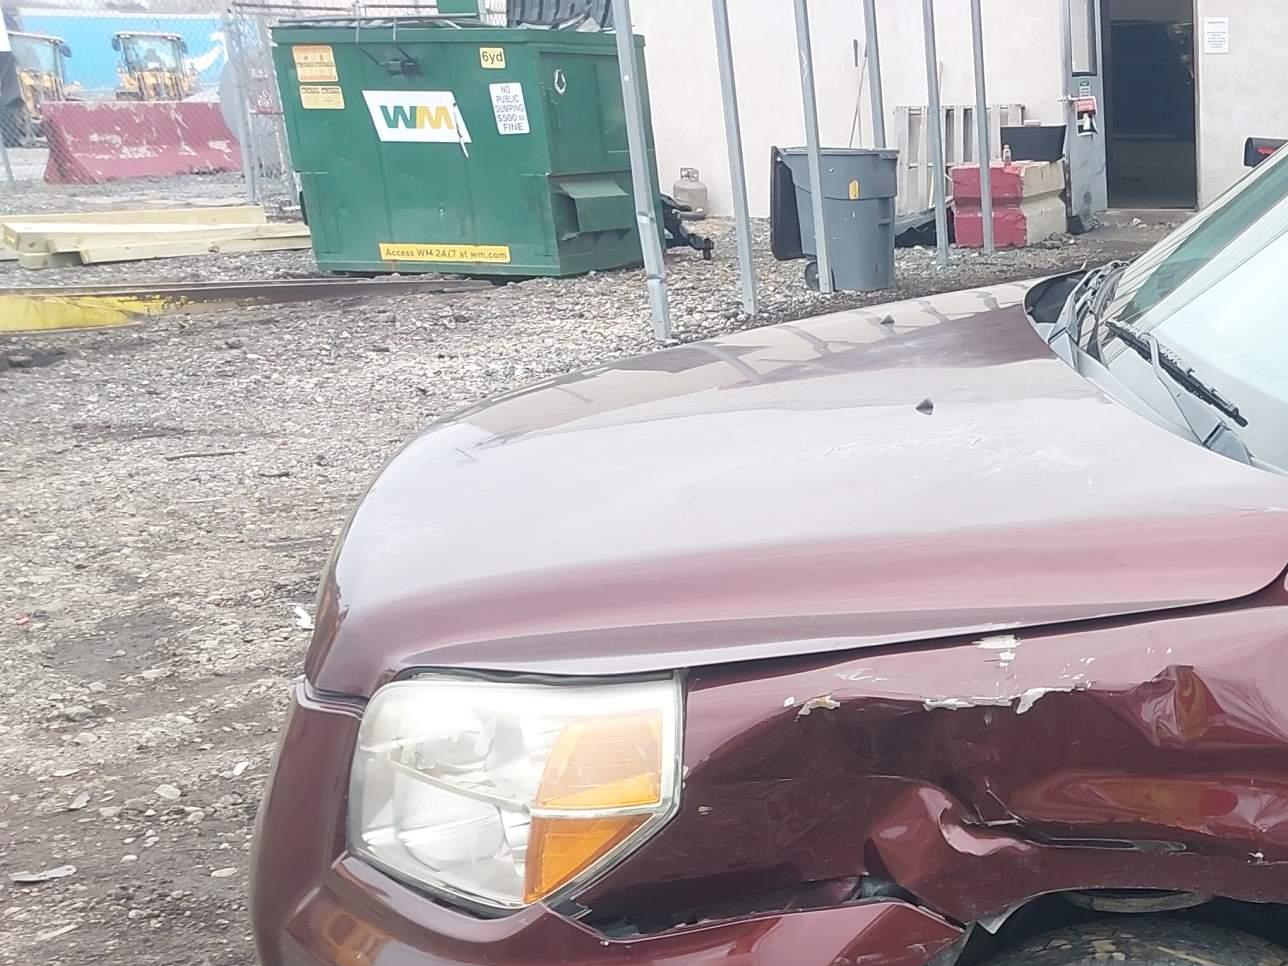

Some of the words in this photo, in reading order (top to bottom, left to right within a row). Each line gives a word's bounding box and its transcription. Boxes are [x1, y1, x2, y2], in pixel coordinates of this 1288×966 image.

[482, 51, 503, 64] 6yd
[500, 86, 511, 94] NO
[496, 95, 520, 103] PUBLIC
[495, 105, 525, 113] DUMPING
[380, 105, 454, 129] WM
[503, 123, 524, 131] FINE
[385, 248, 414, 257] Access
[416, 249, 433, 257] WM
[435, 249, 456, 258] 24/7
[460, 250, 468, 258] at
[471, 251, 507, 259] wm.com
